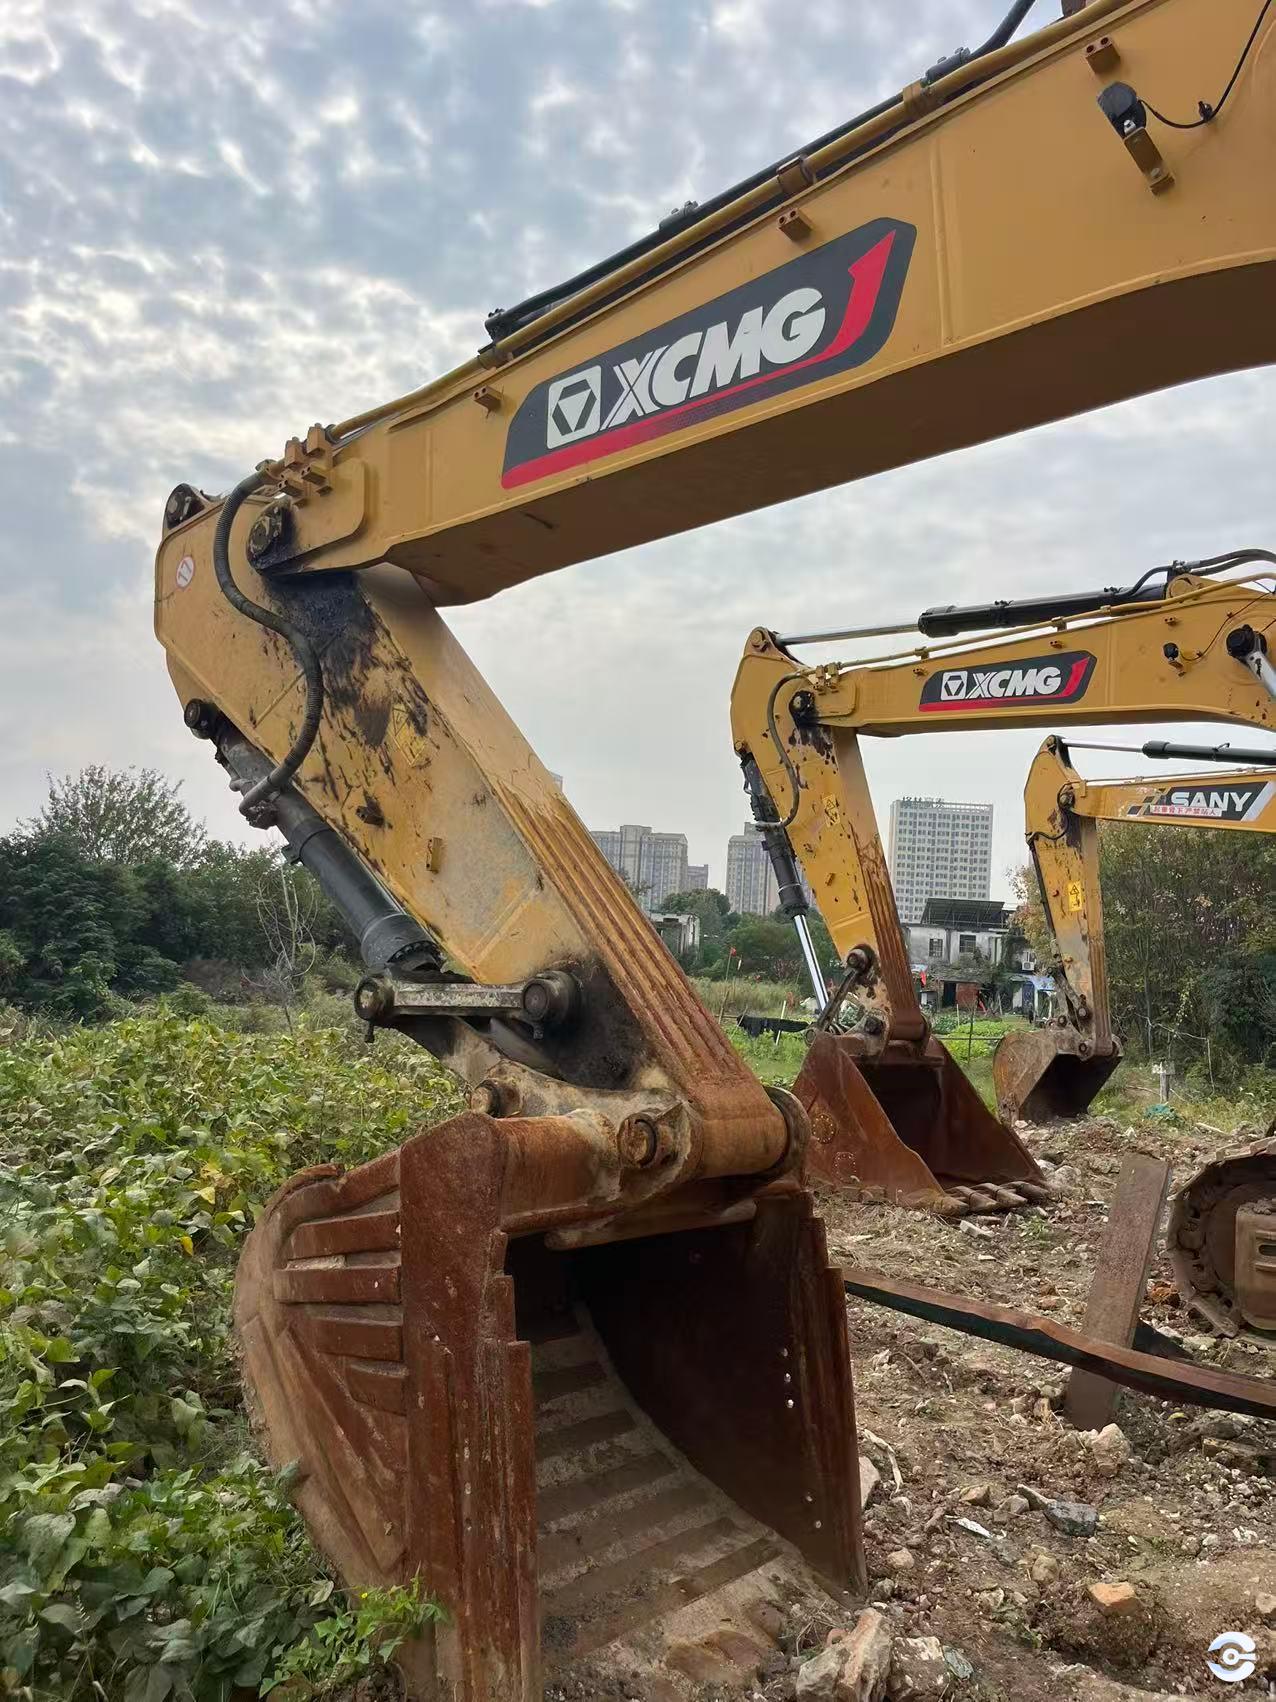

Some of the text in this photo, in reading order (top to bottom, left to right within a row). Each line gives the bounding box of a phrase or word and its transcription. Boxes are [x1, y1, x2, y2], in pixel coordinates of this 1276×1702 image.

[601, 287, 826, 430] XCMG
[966, 666, 1062, 699] XCMG
[1171, 791, 1252, 812] SANY
